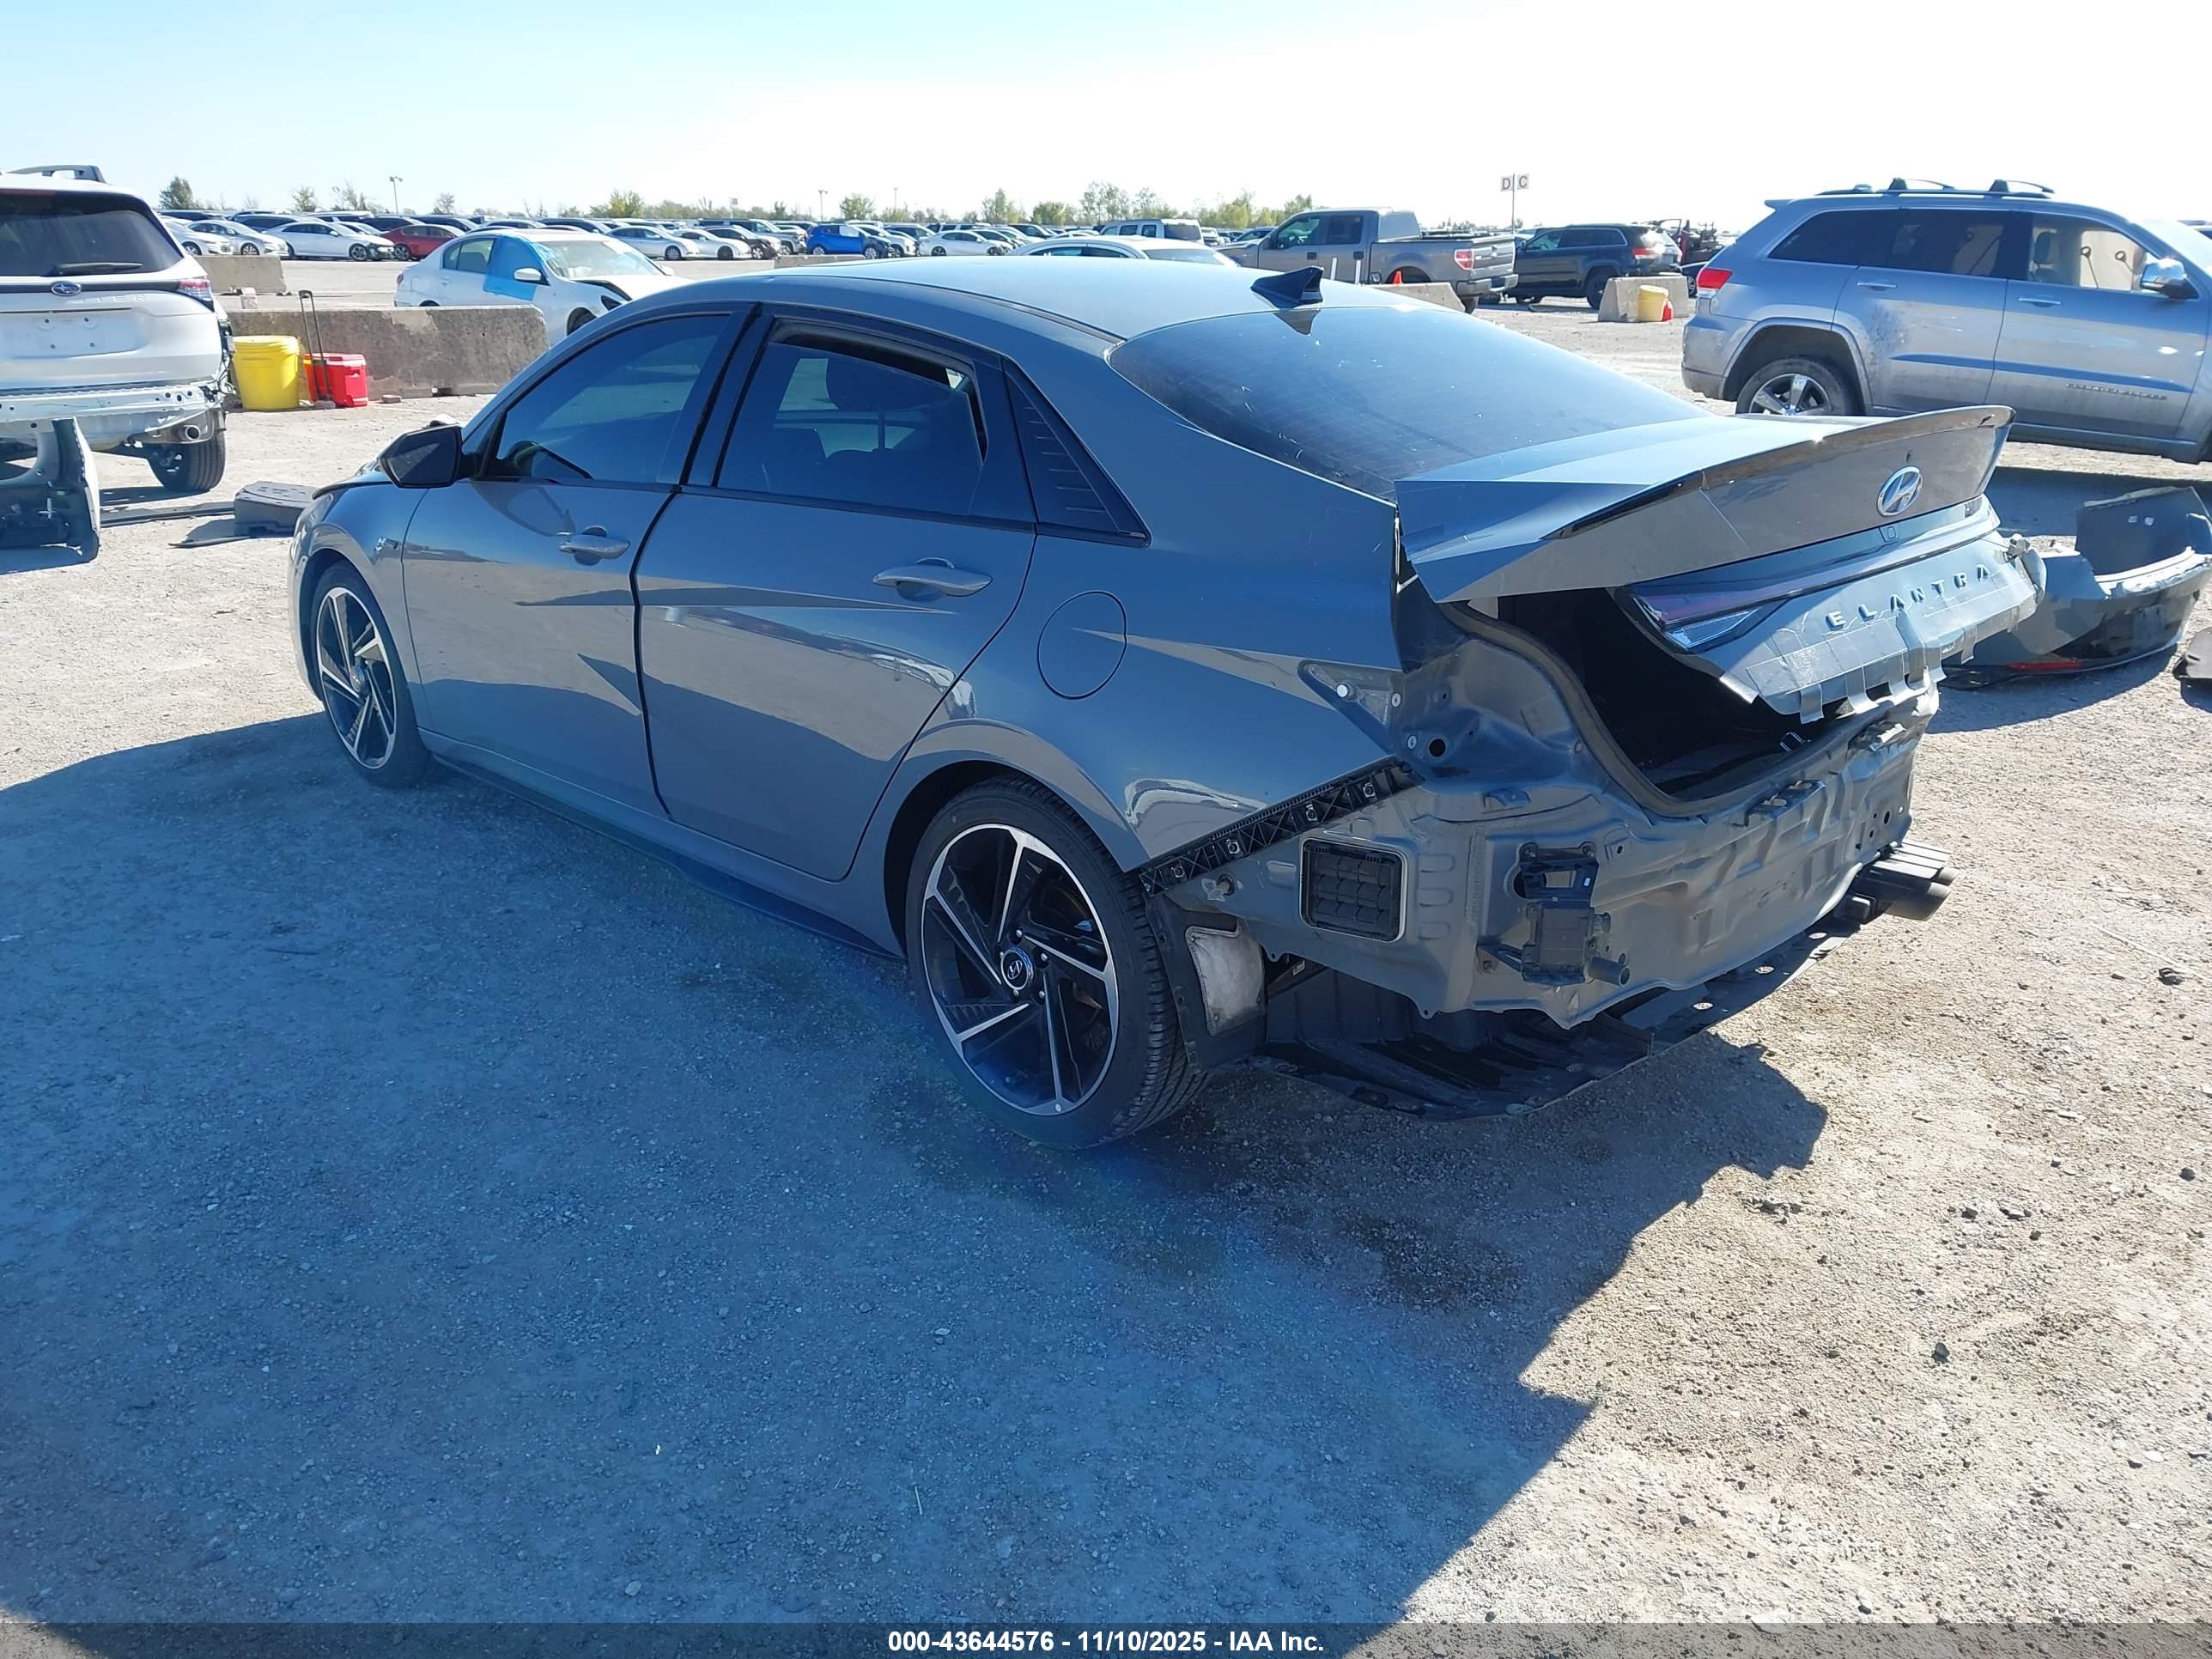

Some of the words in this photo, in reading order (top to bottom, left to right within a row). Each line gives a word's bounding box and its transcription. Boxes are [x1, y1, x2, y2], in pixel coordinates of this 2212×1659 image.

[1503, 178, 1511, 190] D
[1518, 175, 1528, 188] C
[1826, 564, 1990, 631] ELANTRA
